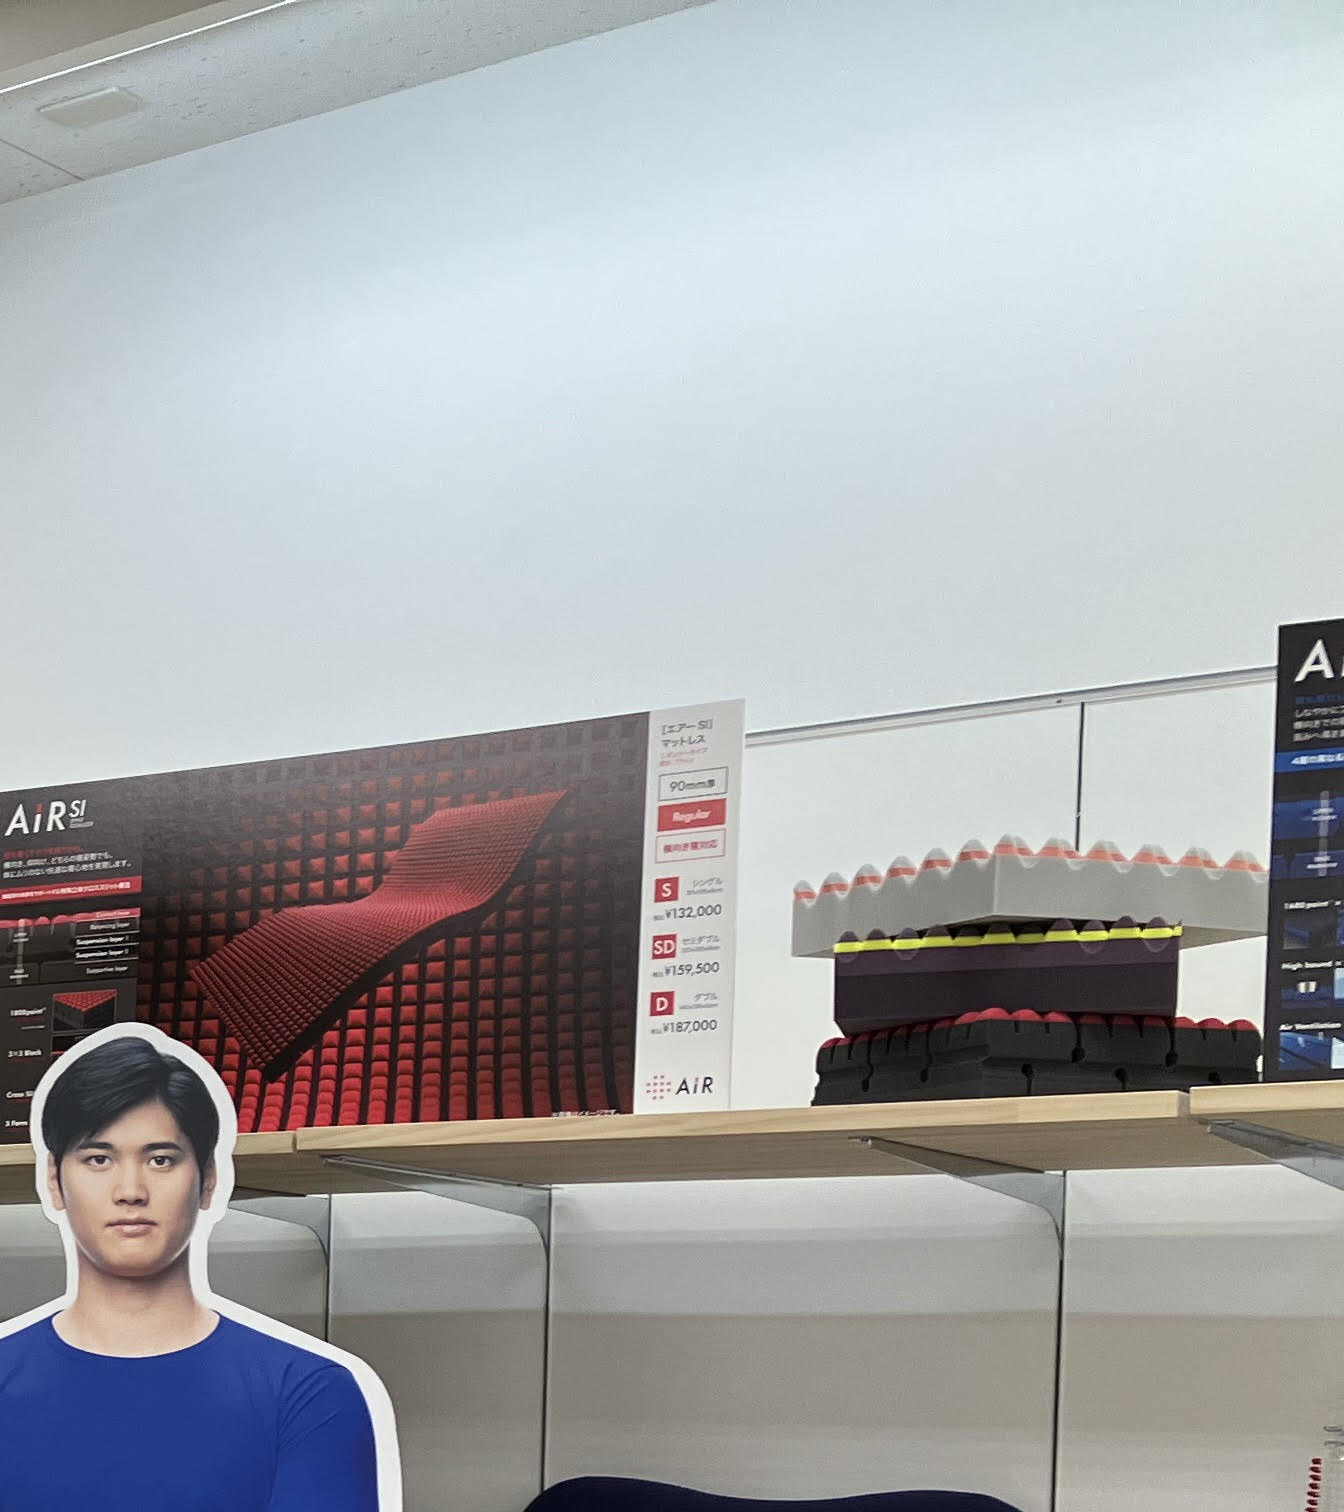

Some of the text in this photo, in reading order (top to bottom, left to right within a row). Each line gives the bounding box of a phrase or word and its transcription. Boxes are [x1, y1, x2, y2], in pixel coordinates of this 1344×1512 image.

[1294, 638, 1344, 682] A
[661, 734, 706, 748] マットレス
[672, 808, 712, 824] Regular
[661, 882, 672, 898] S
[665, 904, 722, 919] ¥132,000
[653, 939, 675, 955] SD
[664, 961, 720, 977] ¥159,500
[655, 996, 669, 1012] D
[662, 1018, 718, 1034] ¥187,000
